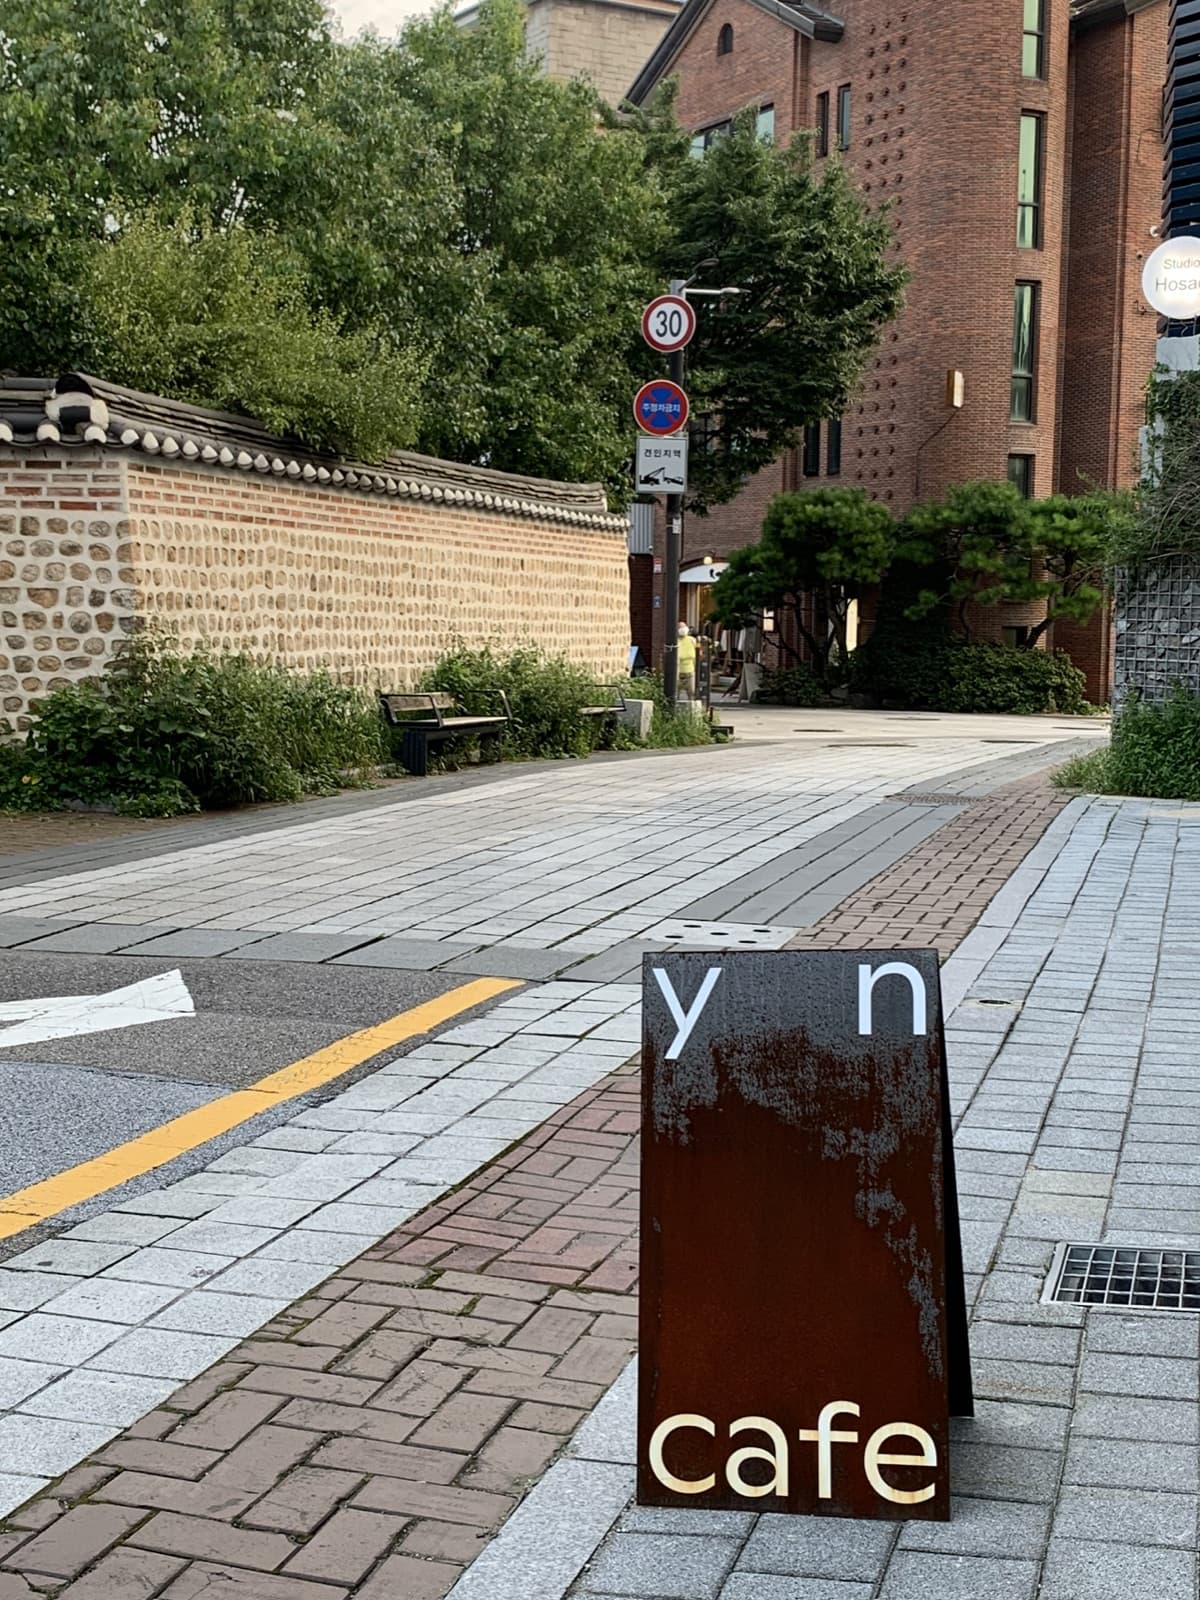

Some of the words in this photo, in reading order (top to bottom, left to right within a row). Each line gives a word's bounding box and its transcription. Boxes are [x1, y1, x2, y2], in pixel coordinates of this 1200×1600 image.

[1163, 258, 1200, 270] Studio
[1155, 277, 1200, 292] Hosa
[655, 310, 682, 338] 30
[644, 448, 681, 458] 견인지역
[652, 967, 722, 1061] y
[858, 961, 927, 1035] n
[649, 1400, 938, 1505] cafe
